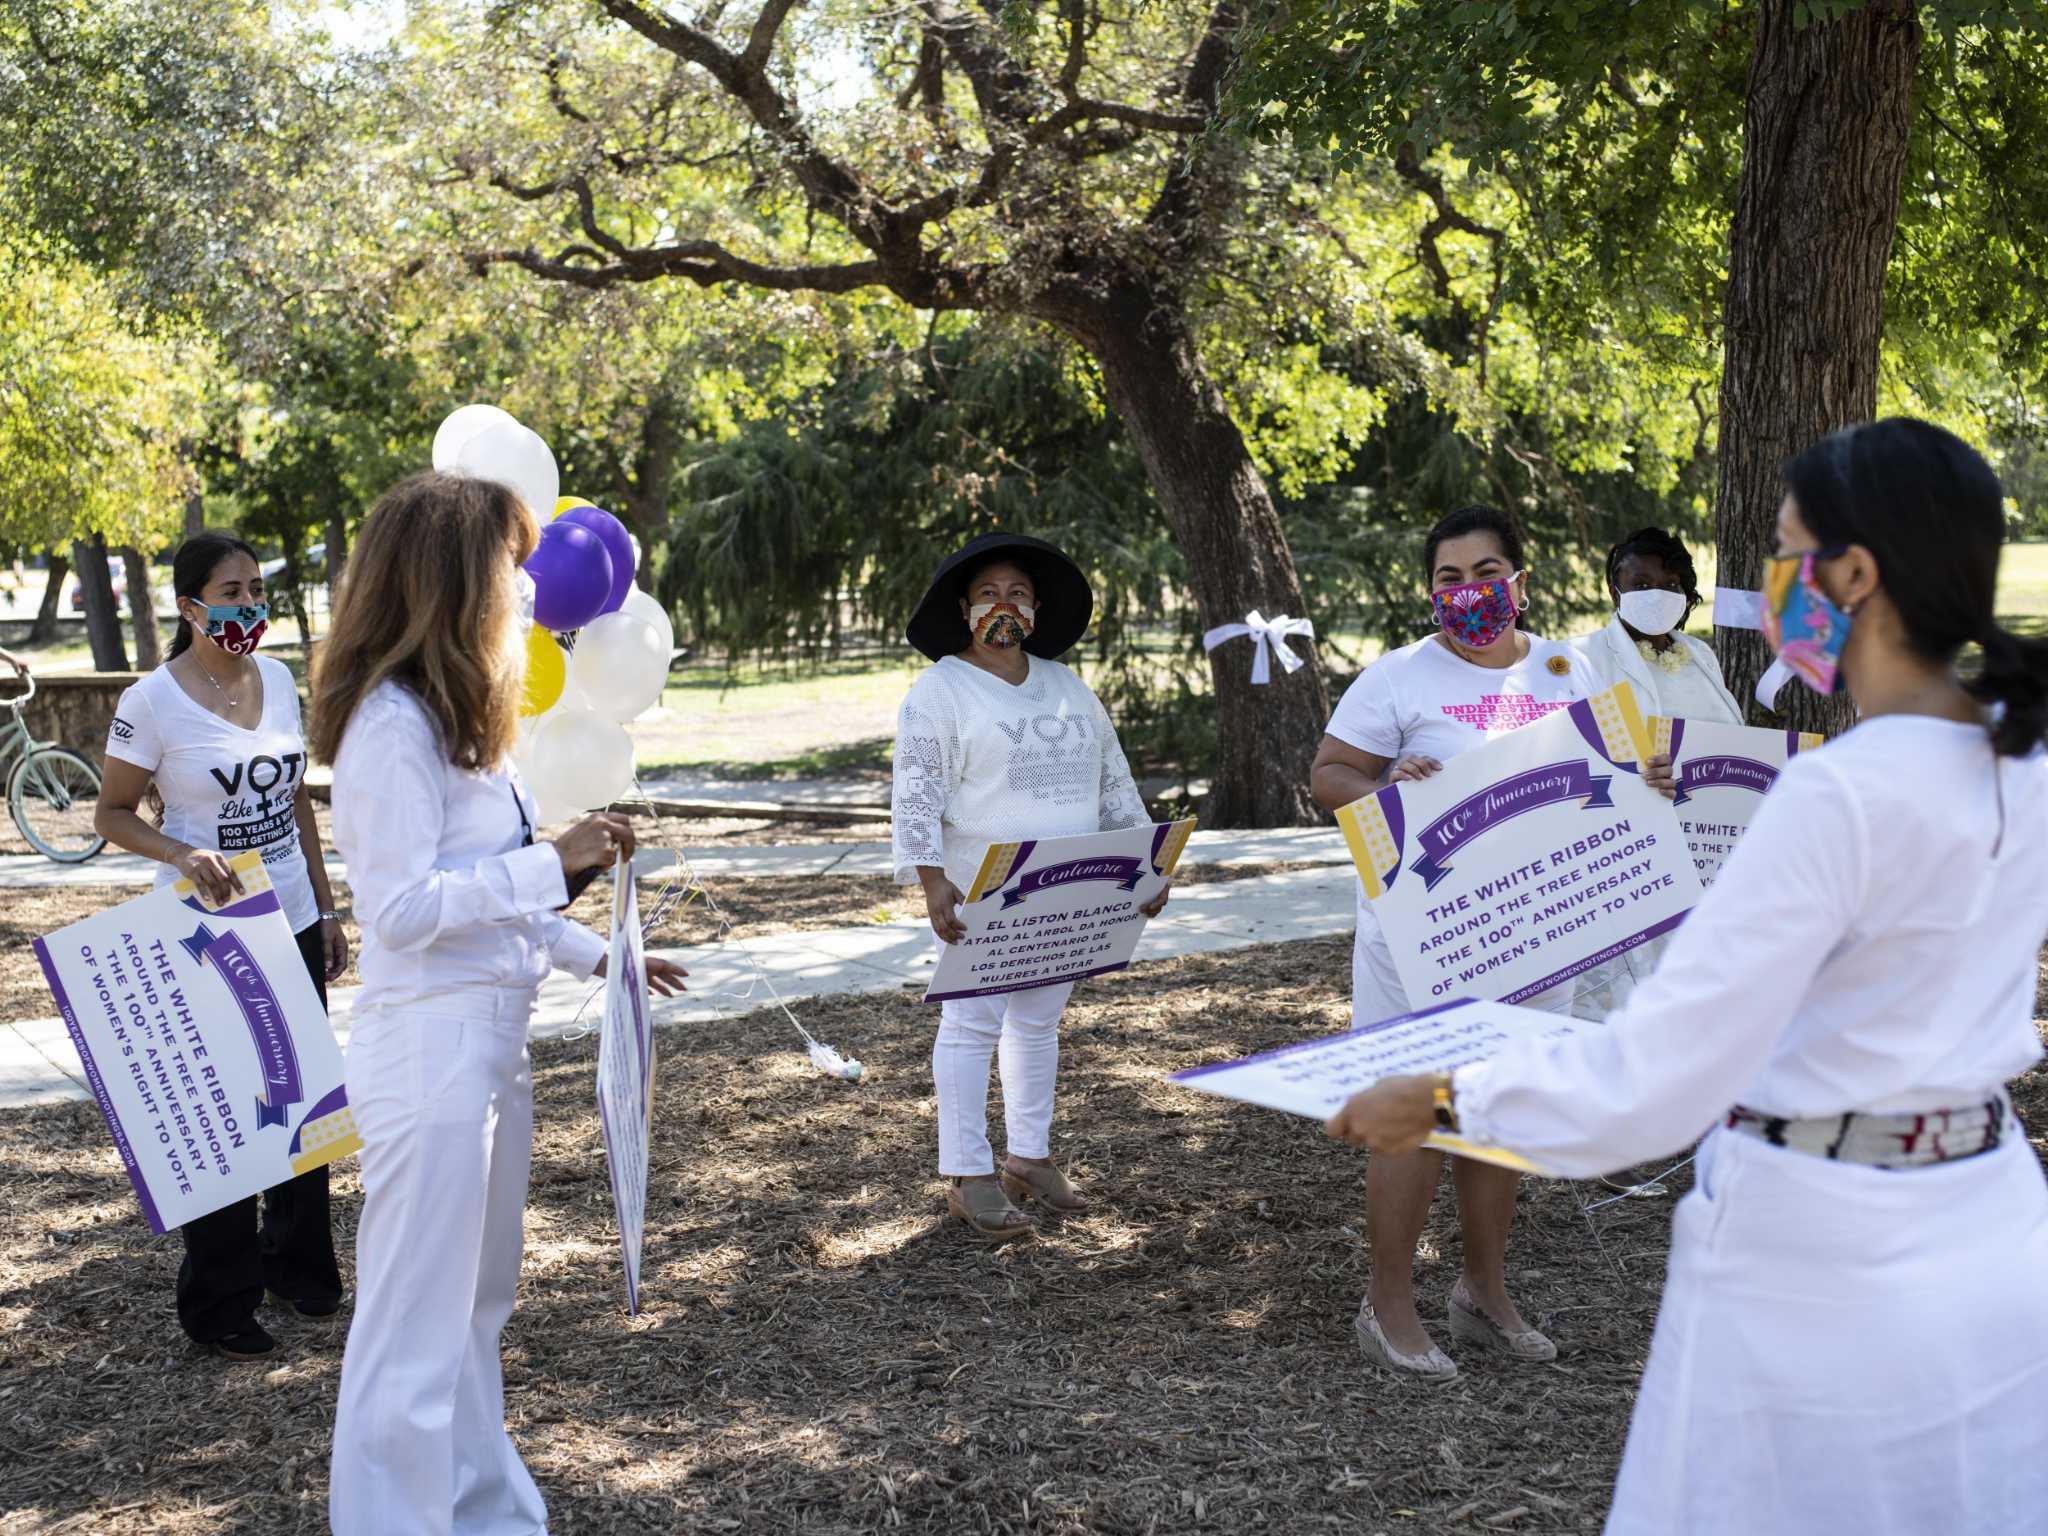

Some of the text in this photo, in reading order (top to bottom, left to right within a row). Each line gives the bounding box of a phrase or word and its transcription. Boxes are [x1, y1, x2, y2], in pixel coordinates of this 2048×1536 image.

[1441, 702, 1575, 714] UNDERESTIMAT
[1480, 694, 1536, 704] NEVER
[995, 713, 1096, 744] VOT
[1454, 714, 1488, 723] THE
[218, 799, 253, 819] Like
[1436, 774, 1574, 847] 100th Anniversary
[222, 828, 241, 836] 100
[245, 820, 274, 834] YEARS
[222, 838, 248, 847] JUST
[250, 827, 283, 846] GETTING
[1696, 823, 1737, 836] WHITE
[1702, 844, 1722, 853] THE
[1038, 863, 1124, 886] Centenario
[1426, 819, 1632, 924] THE WHITE RIBBON
[1419, 834, 1657, 954] AROUND THE TREE HONORS
[964, 913, 1139, 946] ATADO AL ARBOL DA HONOR
[987, 902, 1132, 930] EL LISTON BLANCO
[1436, 944, 1473, 969] THE
[1532, 859, 1652, 925] ANNIVERSARY
[987, 932, 1110, 957] AL CENTENARIO DE
[1431, 873, 1674, 996] OF WOMEN'S RIGHT TO VOTE
[971, 943, 1112, 972] LOS DERECHOS DE LAS
[980, 969, 1038, 984] MUJERES
[1055, 959, 1094, 972] VOTAR
[1503, 933, 1648, 1005] YEARSOFWOMENVOTINGSA.COM
[222, 948, 288, 1089] 100th Anniversary
[120, 932, 231, 1176] AROUND THE TREE HONORS
[149, 938, 245, 1149] THE WHITE RIBBON
[80, 945, 193, 1195] OF WOMEN'S RIGHT TO VOTE
[106, 949, 128, 986] THE
[146, 1049, 207, 1172] ANNIVERSARY
[62, 1005, 135, 1167] 100YEARSOFWOMENVOTINGSA.COM
